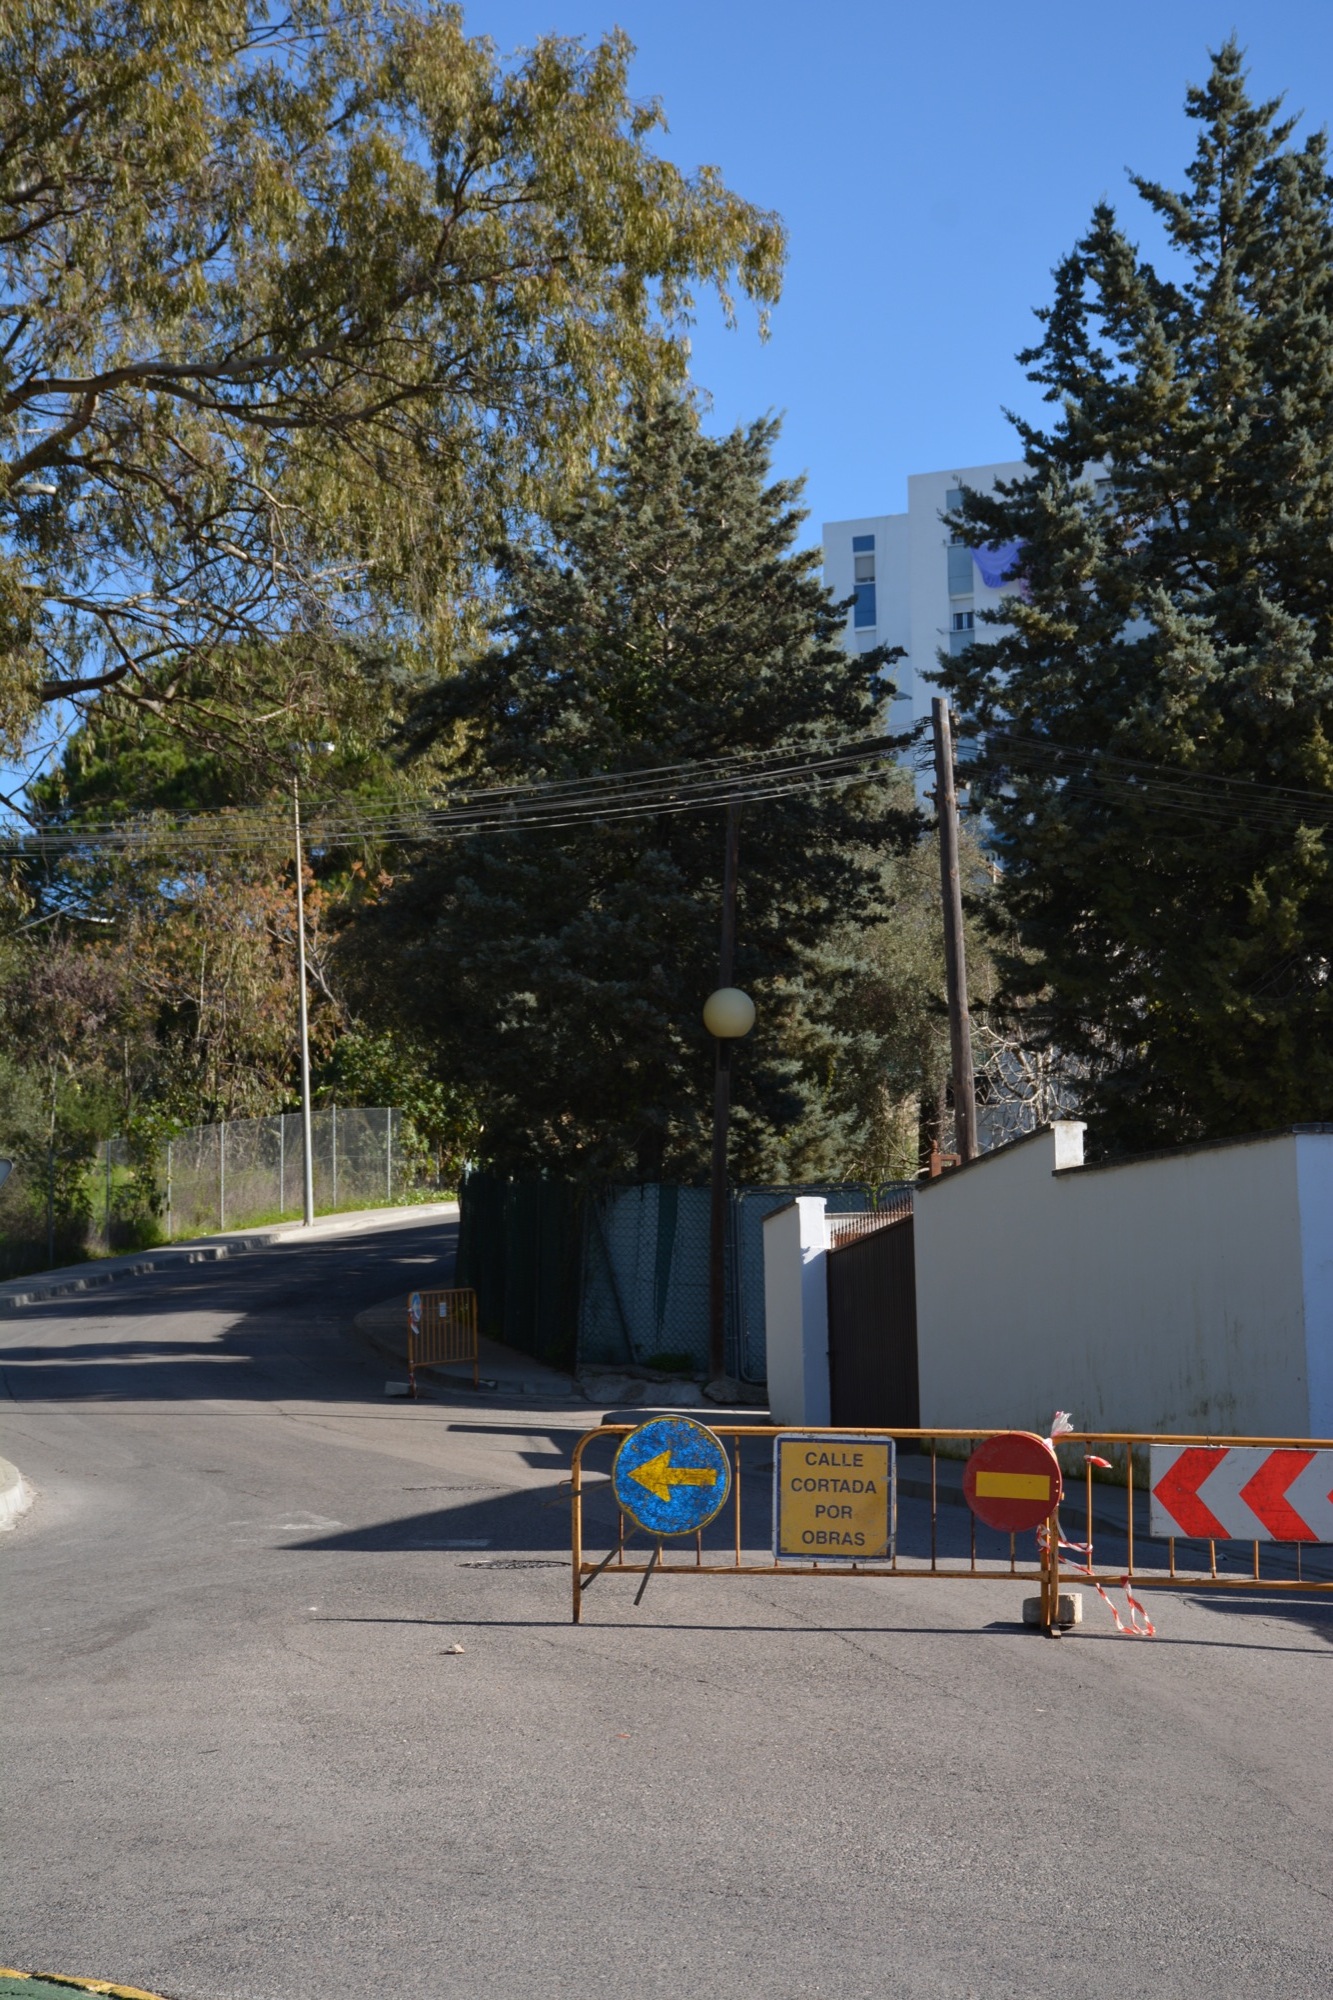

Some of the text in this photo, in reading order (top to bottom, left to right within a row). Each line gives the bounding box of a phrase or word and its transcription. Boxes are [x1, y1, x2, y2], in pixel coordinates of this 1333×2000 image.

[805, 1452, 863, 1467] CALLE
[791, 1478, 877, 1494] CORTADA
[815, 1505, 852, 1519] POR
[802, 1530, 865, 1546] OBRAS
